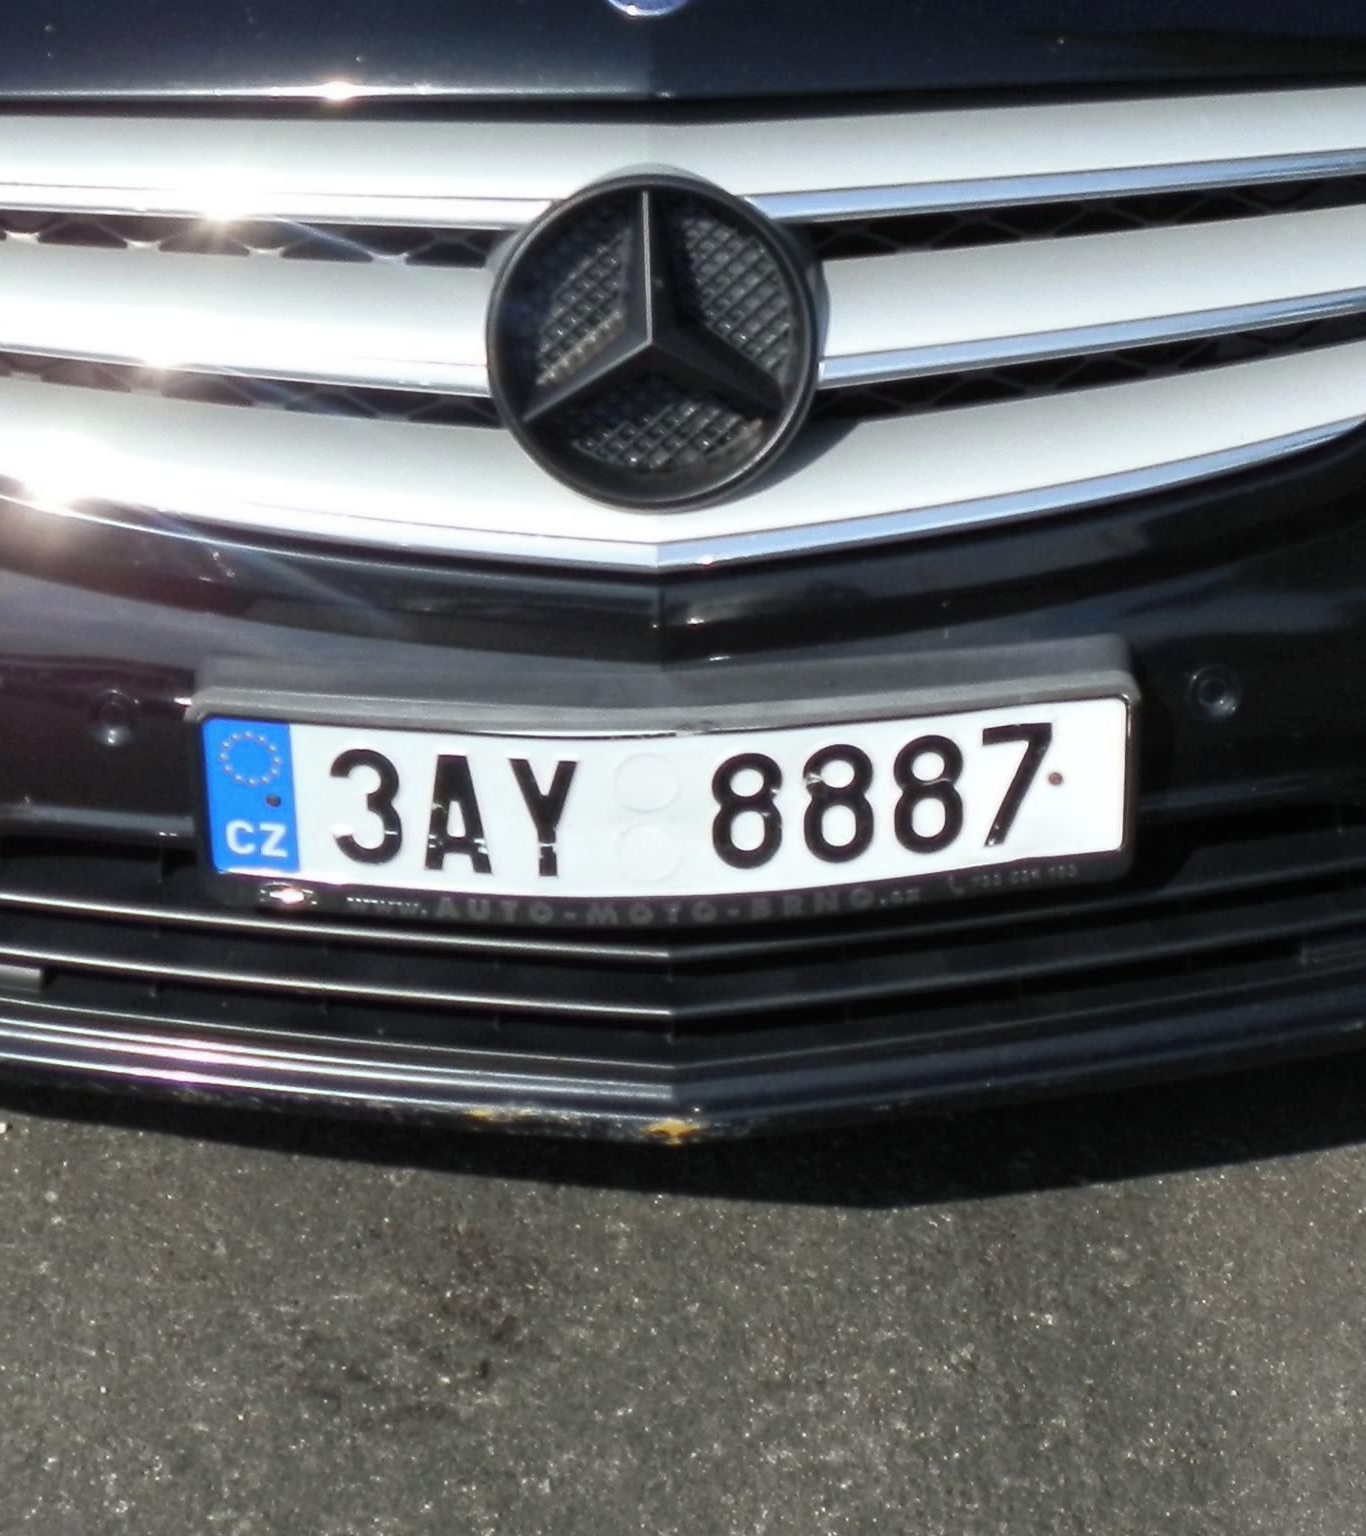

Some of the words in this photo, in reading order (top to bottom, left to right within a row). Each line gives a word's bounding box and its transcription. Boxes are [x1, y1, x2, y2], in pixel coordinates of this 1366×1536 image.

[225, 819, 289, 858] CZ
[330, 747, 579, 877] 3AY
[711, 721, 1053, 869] 8887
